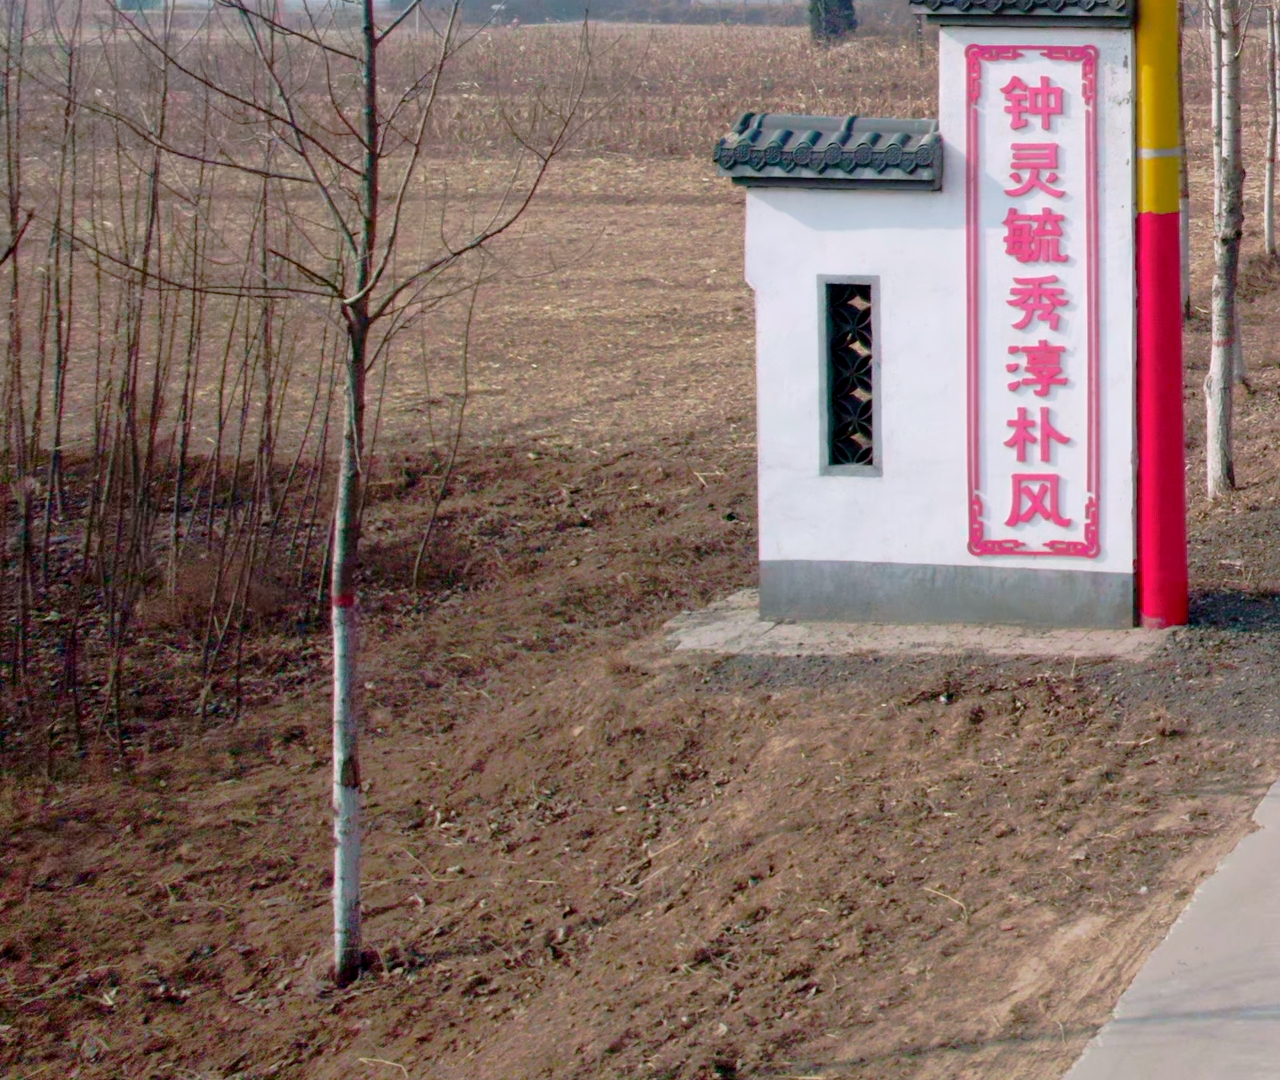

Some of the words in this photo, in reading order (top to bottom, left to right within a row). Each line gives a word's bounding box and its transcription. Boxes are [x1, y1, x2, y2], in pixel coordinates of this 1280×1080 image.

[1001, 76, 1071, 527] 钟灵毓秀淳朴风
